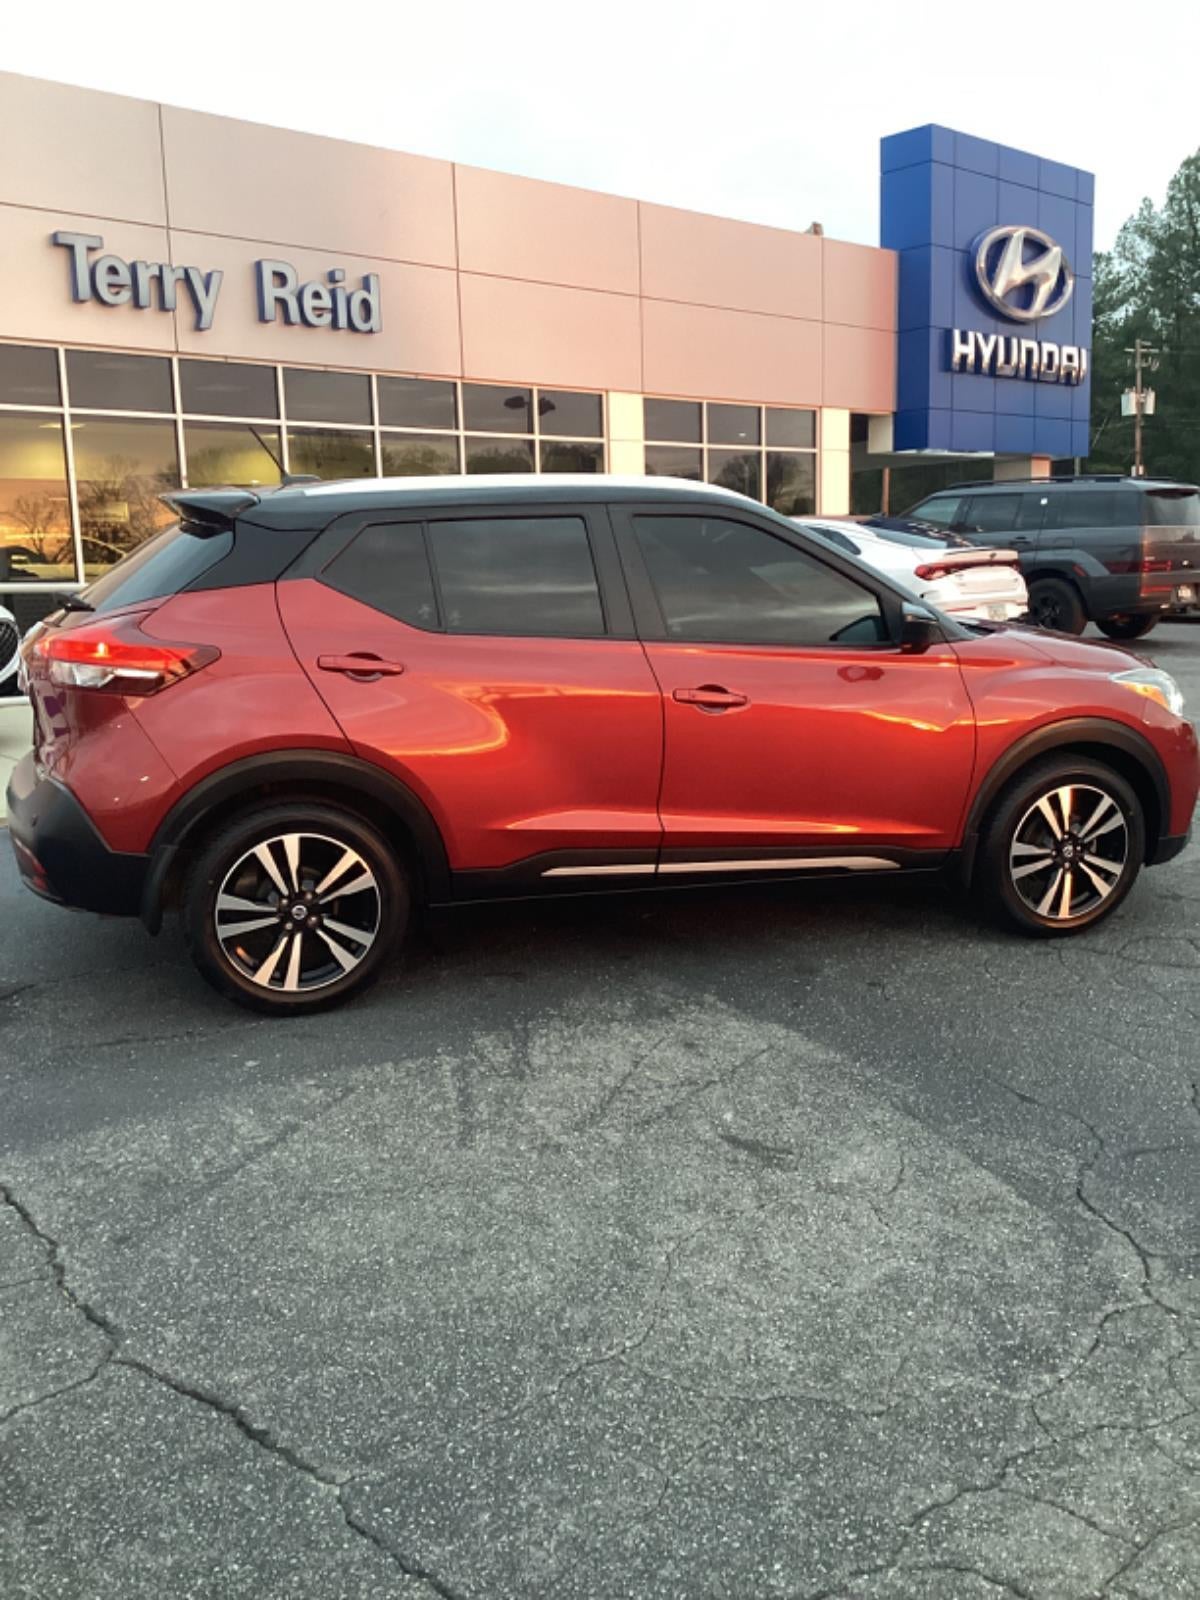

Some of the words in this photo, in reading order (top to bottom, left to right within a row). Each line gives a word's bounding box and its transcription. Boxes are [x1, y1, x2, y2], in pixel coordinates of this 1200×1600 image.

[52, 231, 223, 330] Terry
[255, 259, 381, 333] Reid
[951, 328, 1087, 385] HYUNDAI
